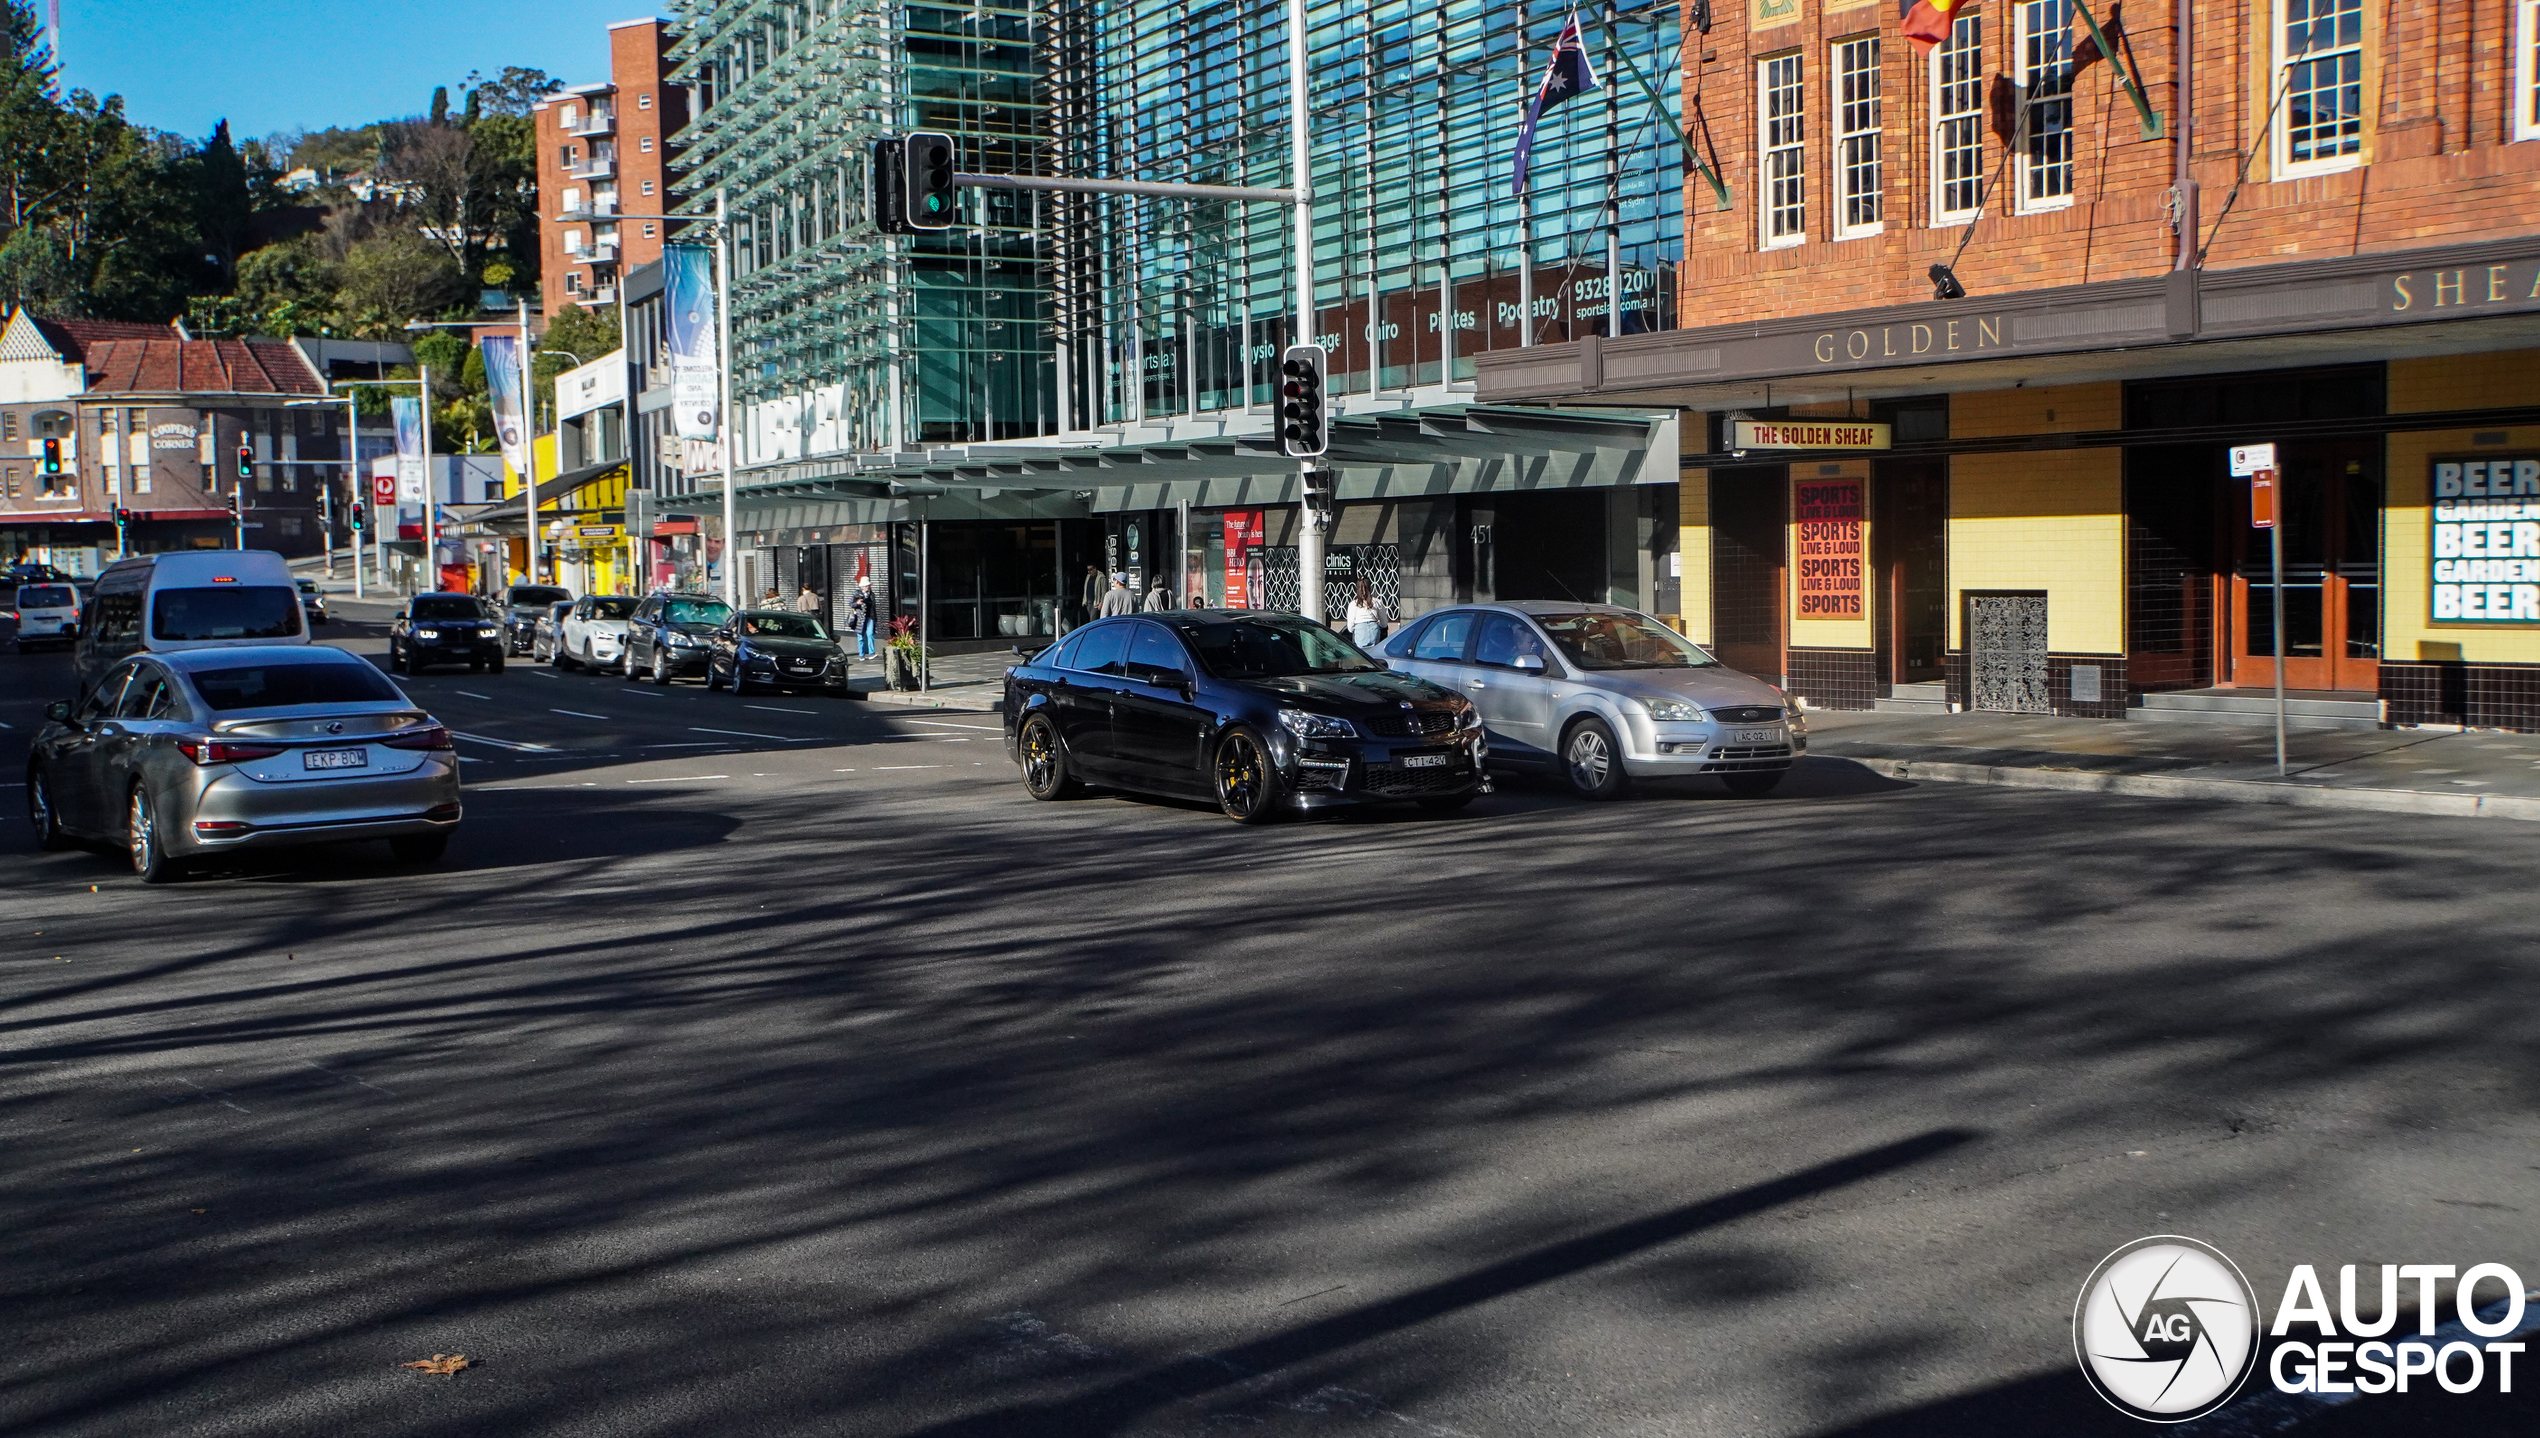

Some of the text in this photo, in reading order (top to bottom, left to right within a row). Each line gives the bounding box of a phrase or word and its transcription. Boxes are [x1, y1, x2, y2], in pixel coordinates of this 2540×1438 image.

[1575, 277, 1610, 301] 9328
[1498, 295, 1559, 323] Poatry
[1430, 310, 1475, 333] Piates
[1815, 316, 2001, 363] GOLDEN
[747, 382, 850, 465] LIBRARY
[153, 438, 196, 449] CORNER
[1754, 426, 1874, 445] THE GOLDEN SHEAF
[2435, 460, 2540, 497] BEER
[1801, 485, 1860, 506] SPORTS
[1801, 505, 1822, 519] LIVE
[1833, 505, 1860, 518] LOUD
[2434, 499, 2540, 522] GARDEN
[1470, 525, 1493, 544] 451
[1801, 521, 1860, 541] SPORTS
[2434, 521, 2540, 558] BEER
[1801, 541, 1860, 555] LIVE & LOUD
[1325, 552, 1351, 568] clinics
[1801, 558, 1860, 578] SPORTS
[2433, 559, 2540, 582] GARDEN
[1801, 578, 1860, 591] LIVE & LOUD
[1801, 594, 1860, 614] SPORTS
[2433, 583, 2540, 619] BEER
